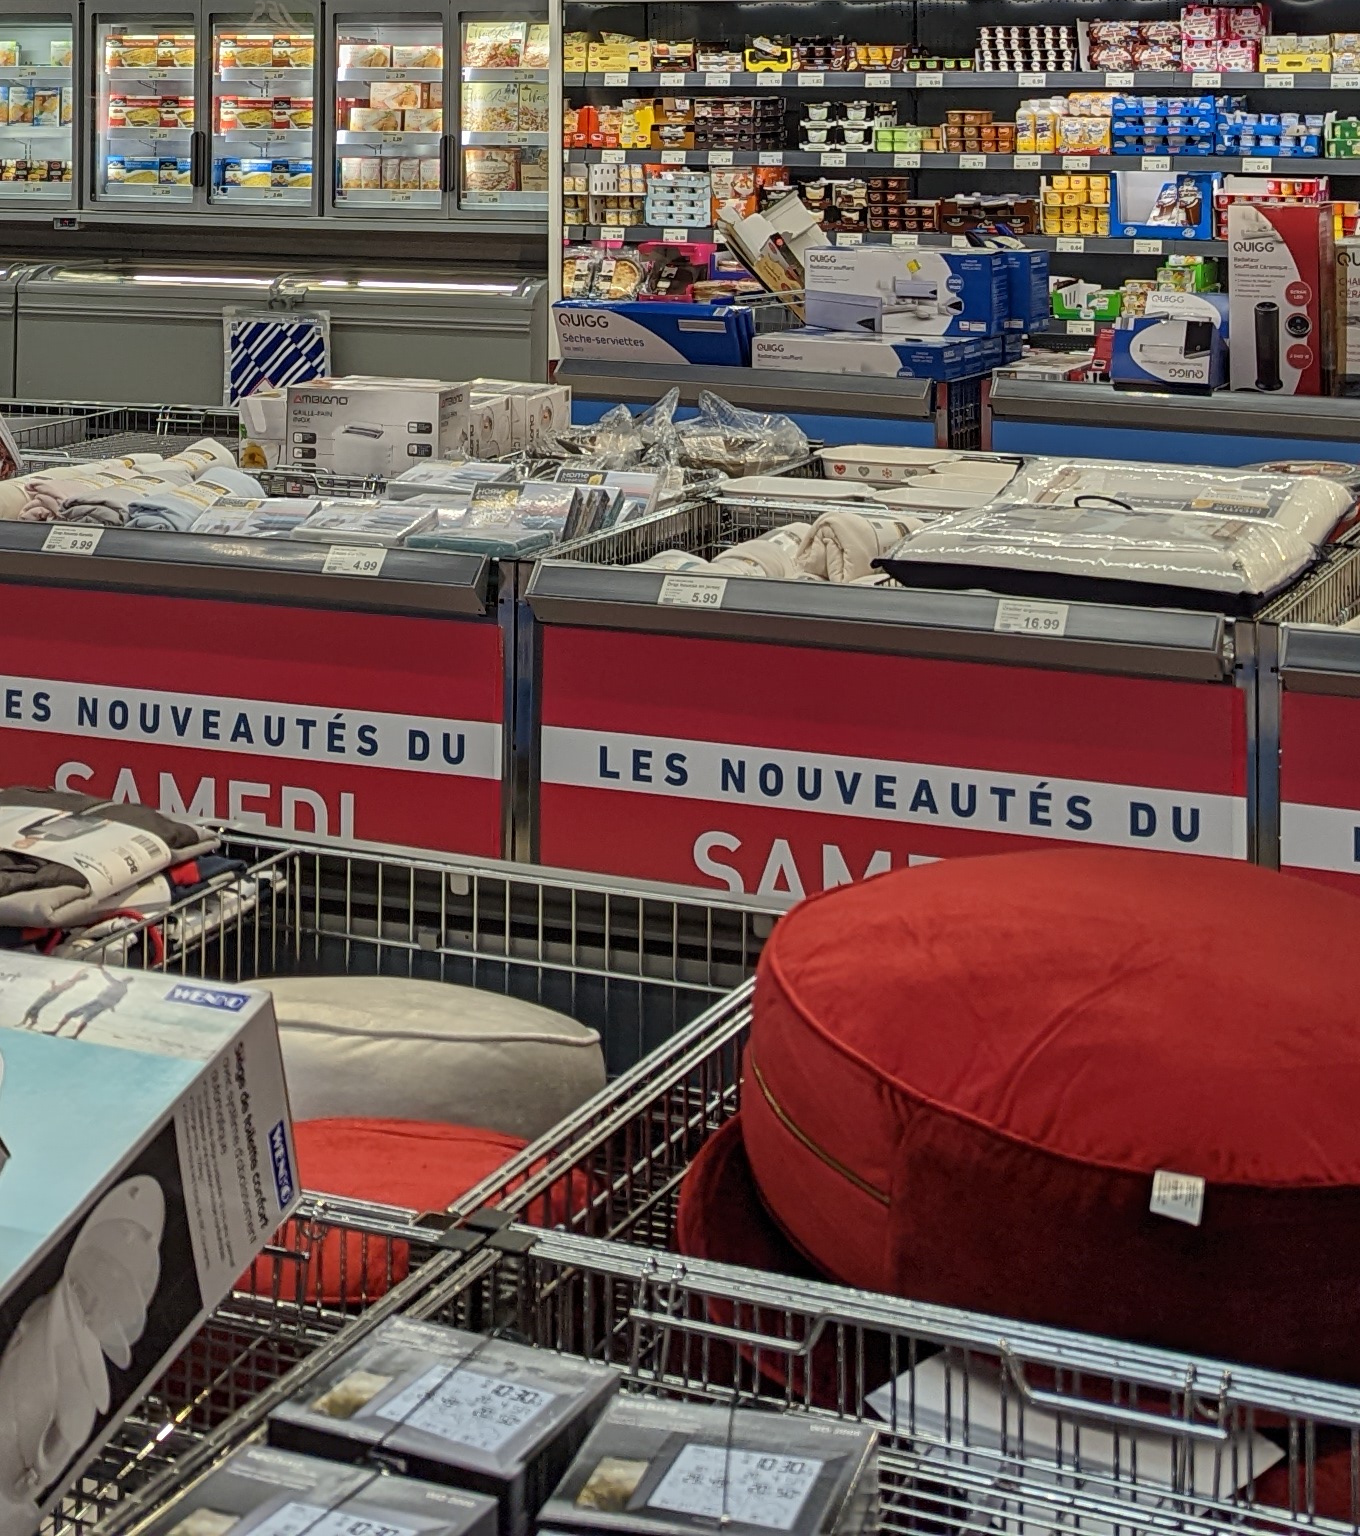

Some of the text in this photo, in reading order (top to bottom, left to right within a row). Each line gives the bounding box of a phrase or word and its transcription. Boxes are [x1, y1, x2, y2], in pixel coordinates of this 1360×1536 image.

[1233, 241, 1275, 253] QUIGG
[809, 254, 837, 264] QUIGG
[558, 312, 609, 330] QUIGG
[562, 331, 645, 348] Sèche-serviettes
[756, 342, 785, 353] QUIGG
[1168, 368, 1204, 379] QUIGG
[293, 395, 348, 405] AMBIANO
[69, 539, 93, 550] 9.99
[352, 560, 378, 571] 4.99
[691, 592, 718, 604] 5.99
[1024, 616, 1060, 630] 16.99
[78, 696, 378, 757] NOUVEAUTÉS
[407, 730, 466, 765] DU
[598, 745, 1200, 844] LES NOUVEAUTÉS DU
[171, 987, 248, 1010] WENKO
[270, 1122, 291, 1204] WENKO
